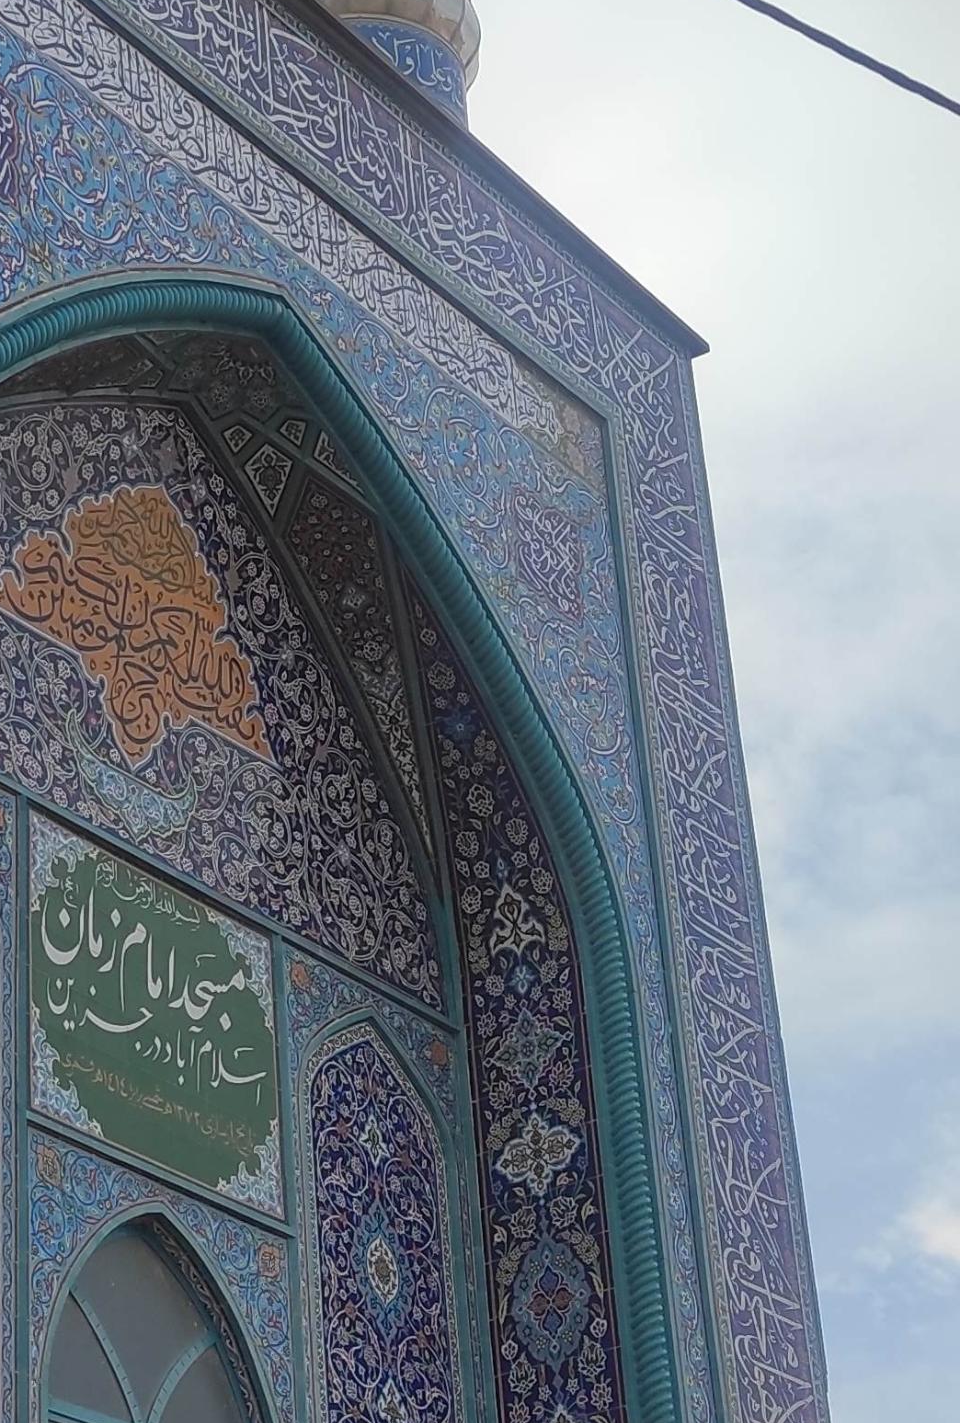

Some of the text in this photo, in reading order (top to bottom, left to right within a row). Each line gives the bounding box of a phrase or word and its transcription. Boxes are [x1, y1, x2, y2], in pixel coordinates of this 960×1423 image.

[41, 887, 122, 974] زمان
[122, 922, 176, 1012] امام
[169, 953, 248, 1030] مسجد
[196, 1036, 267, 1105] اسلام
